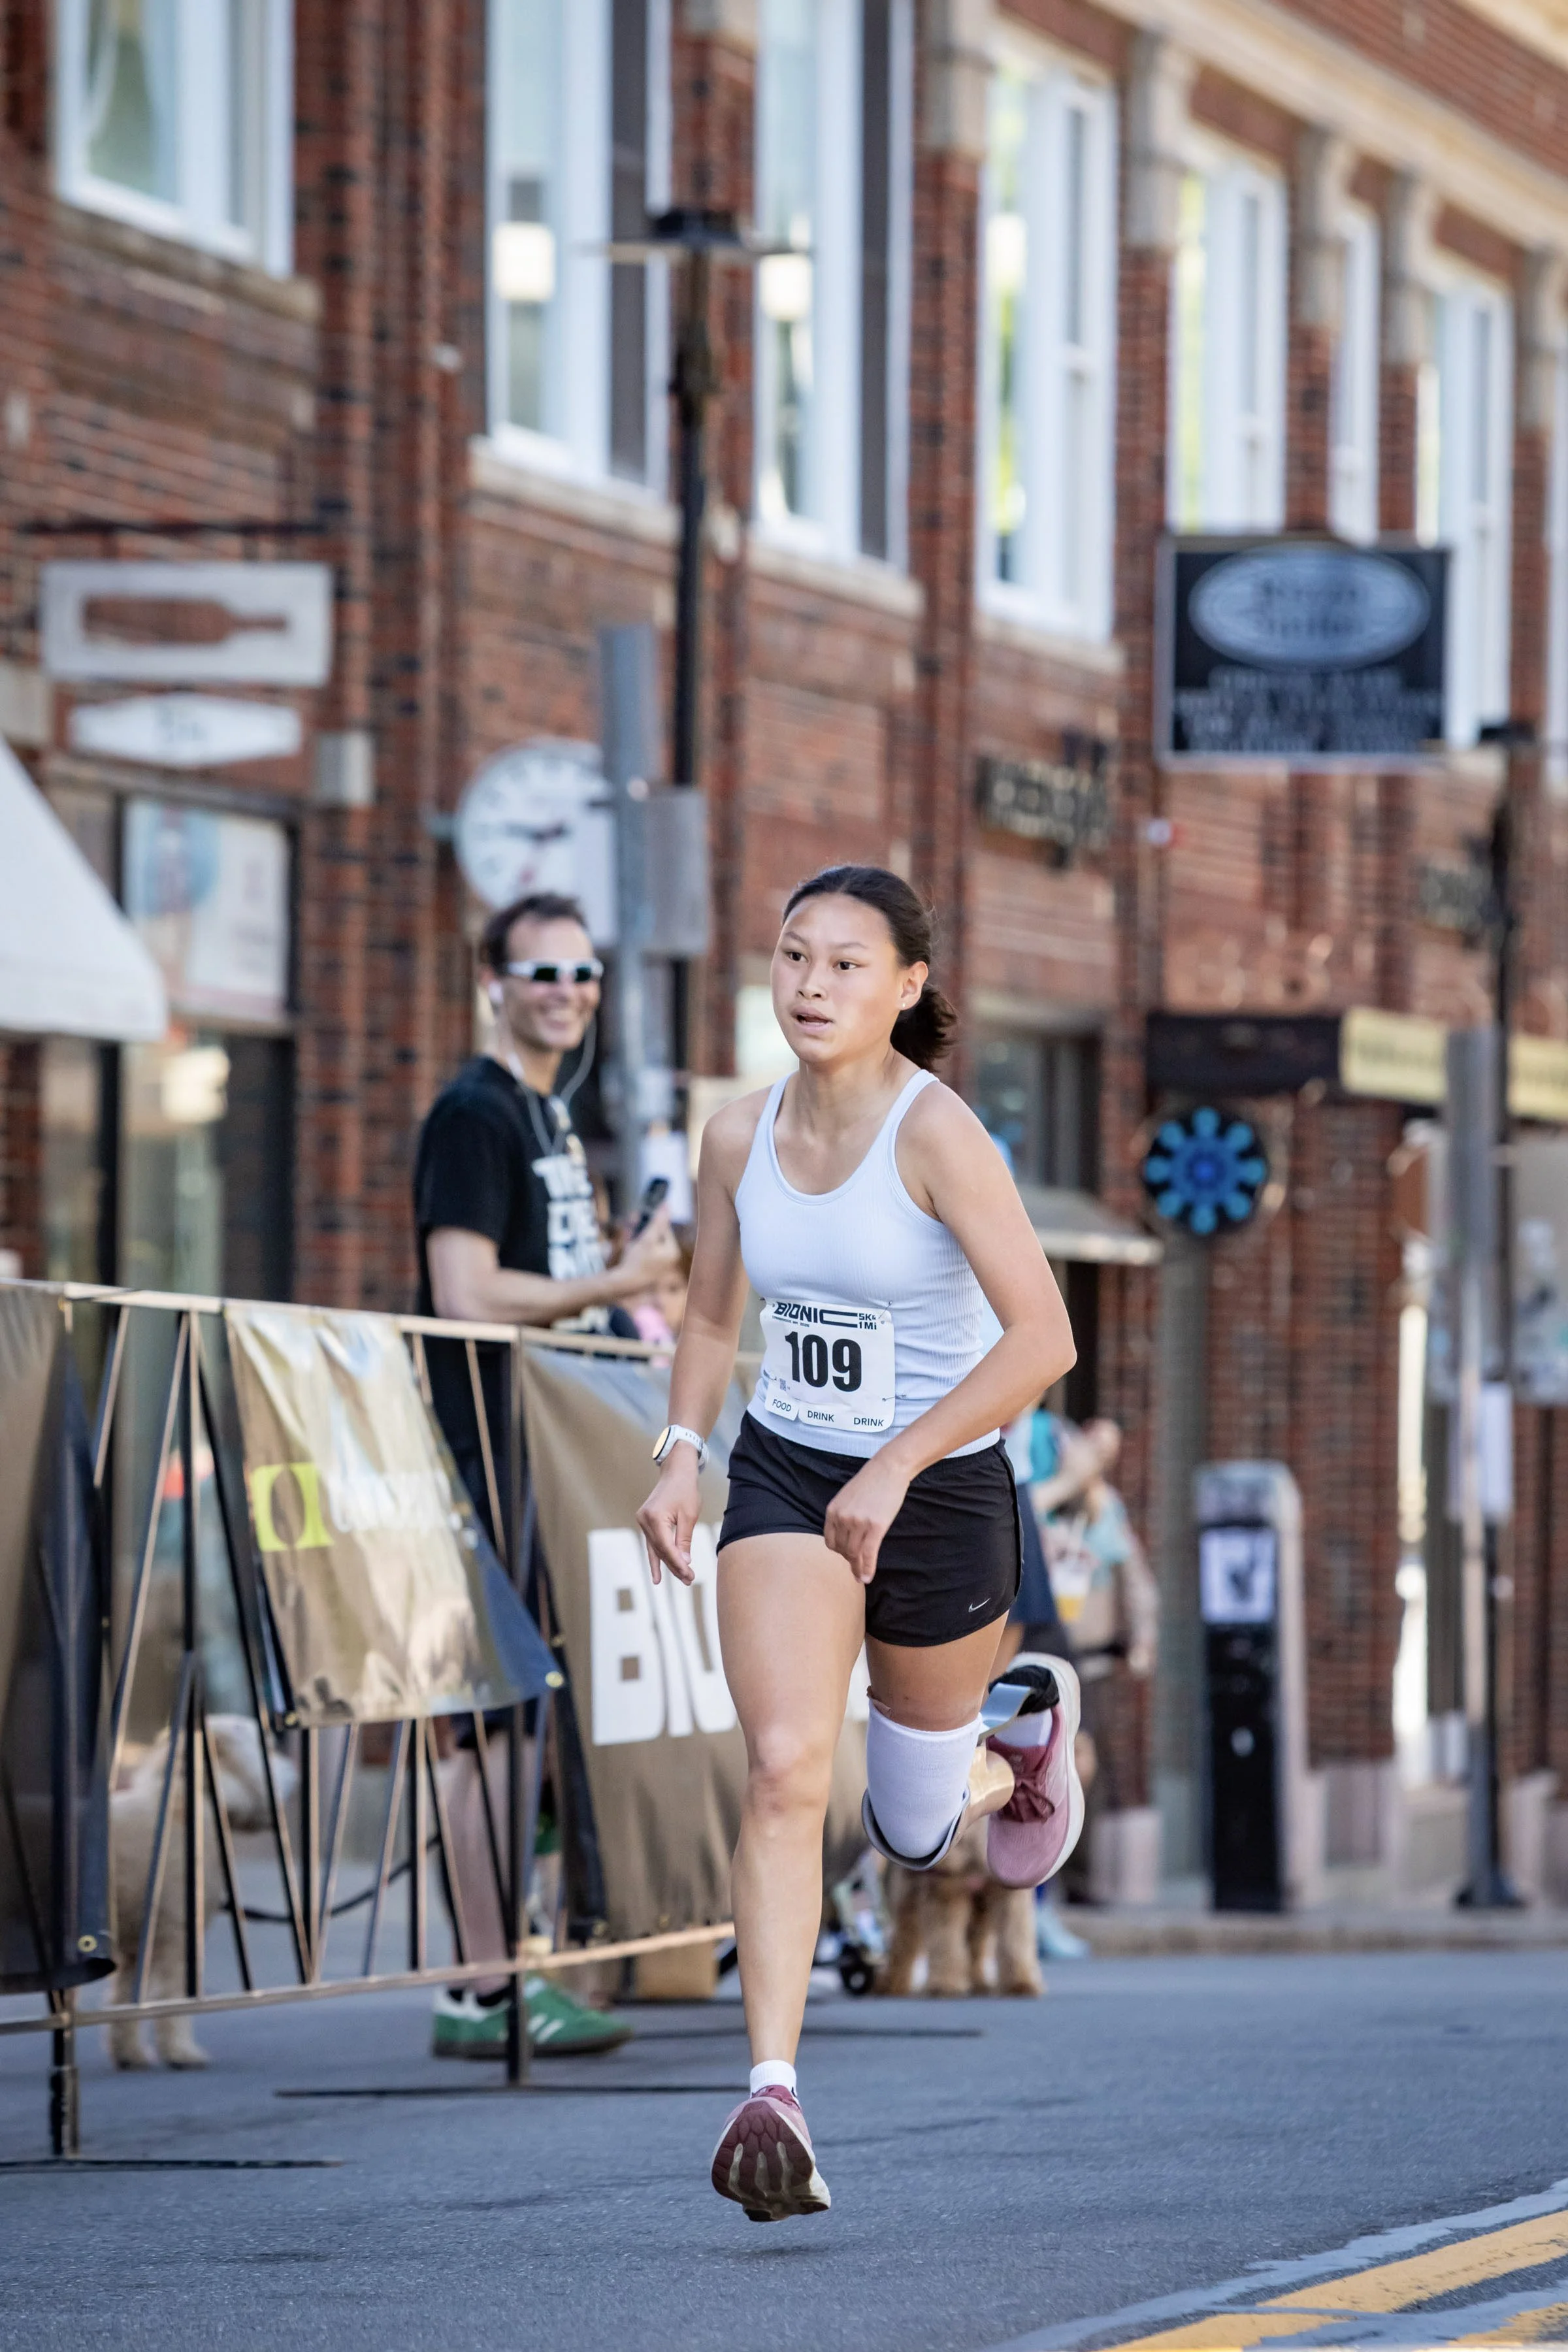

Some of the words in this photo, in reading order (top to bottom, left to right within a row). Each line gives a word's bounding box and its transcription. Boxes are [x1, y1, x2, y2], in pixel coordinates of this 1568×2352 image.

[774, 1301, 858, 1328] BIONIC
[785, 1331, 862, 1392] 109
[772, 1399, 791, 1412] FOOD
[808, 1411, 834, 1422] DRINK
[854, 1417, 884, 1426] DRINK
